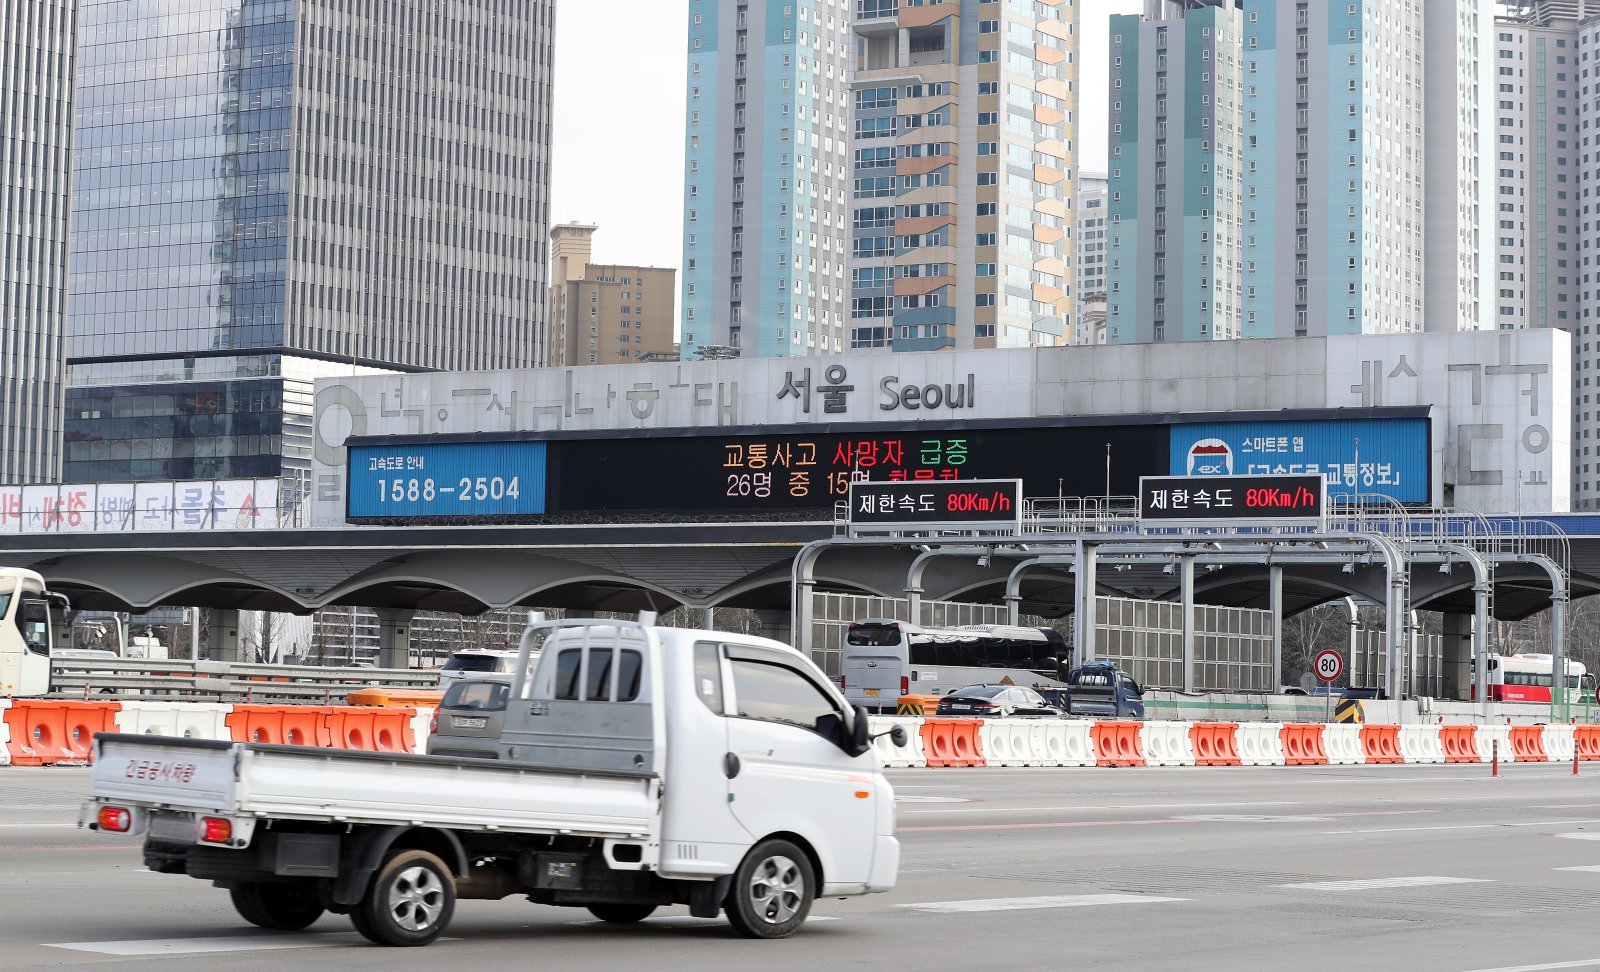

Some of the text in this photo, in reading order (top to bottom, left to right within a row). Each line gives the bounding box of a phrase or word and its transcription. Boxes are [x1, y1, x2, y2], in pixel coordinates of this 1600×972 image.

[776, 364, 854, 413] 서울
[879, 373, 975, 411] Seoul
[723, 439, 968, 469] 교통사고 사망자 급증
[1241, 436, 1304, 453] 스마트폰 앱
[368, 455, 425, 471] 고속도로 안내
[377, 476, 520, 502] 1588-2504
[726, 471, 772, 497] 26명
[788, 471, 810, 497] 중
[859, 491, 1010, 514] 제한속도 80Km/h
[1150, 486, 1314, 510] 제한속도 80Km/h
[1321, 659, 1336, 672] 80
